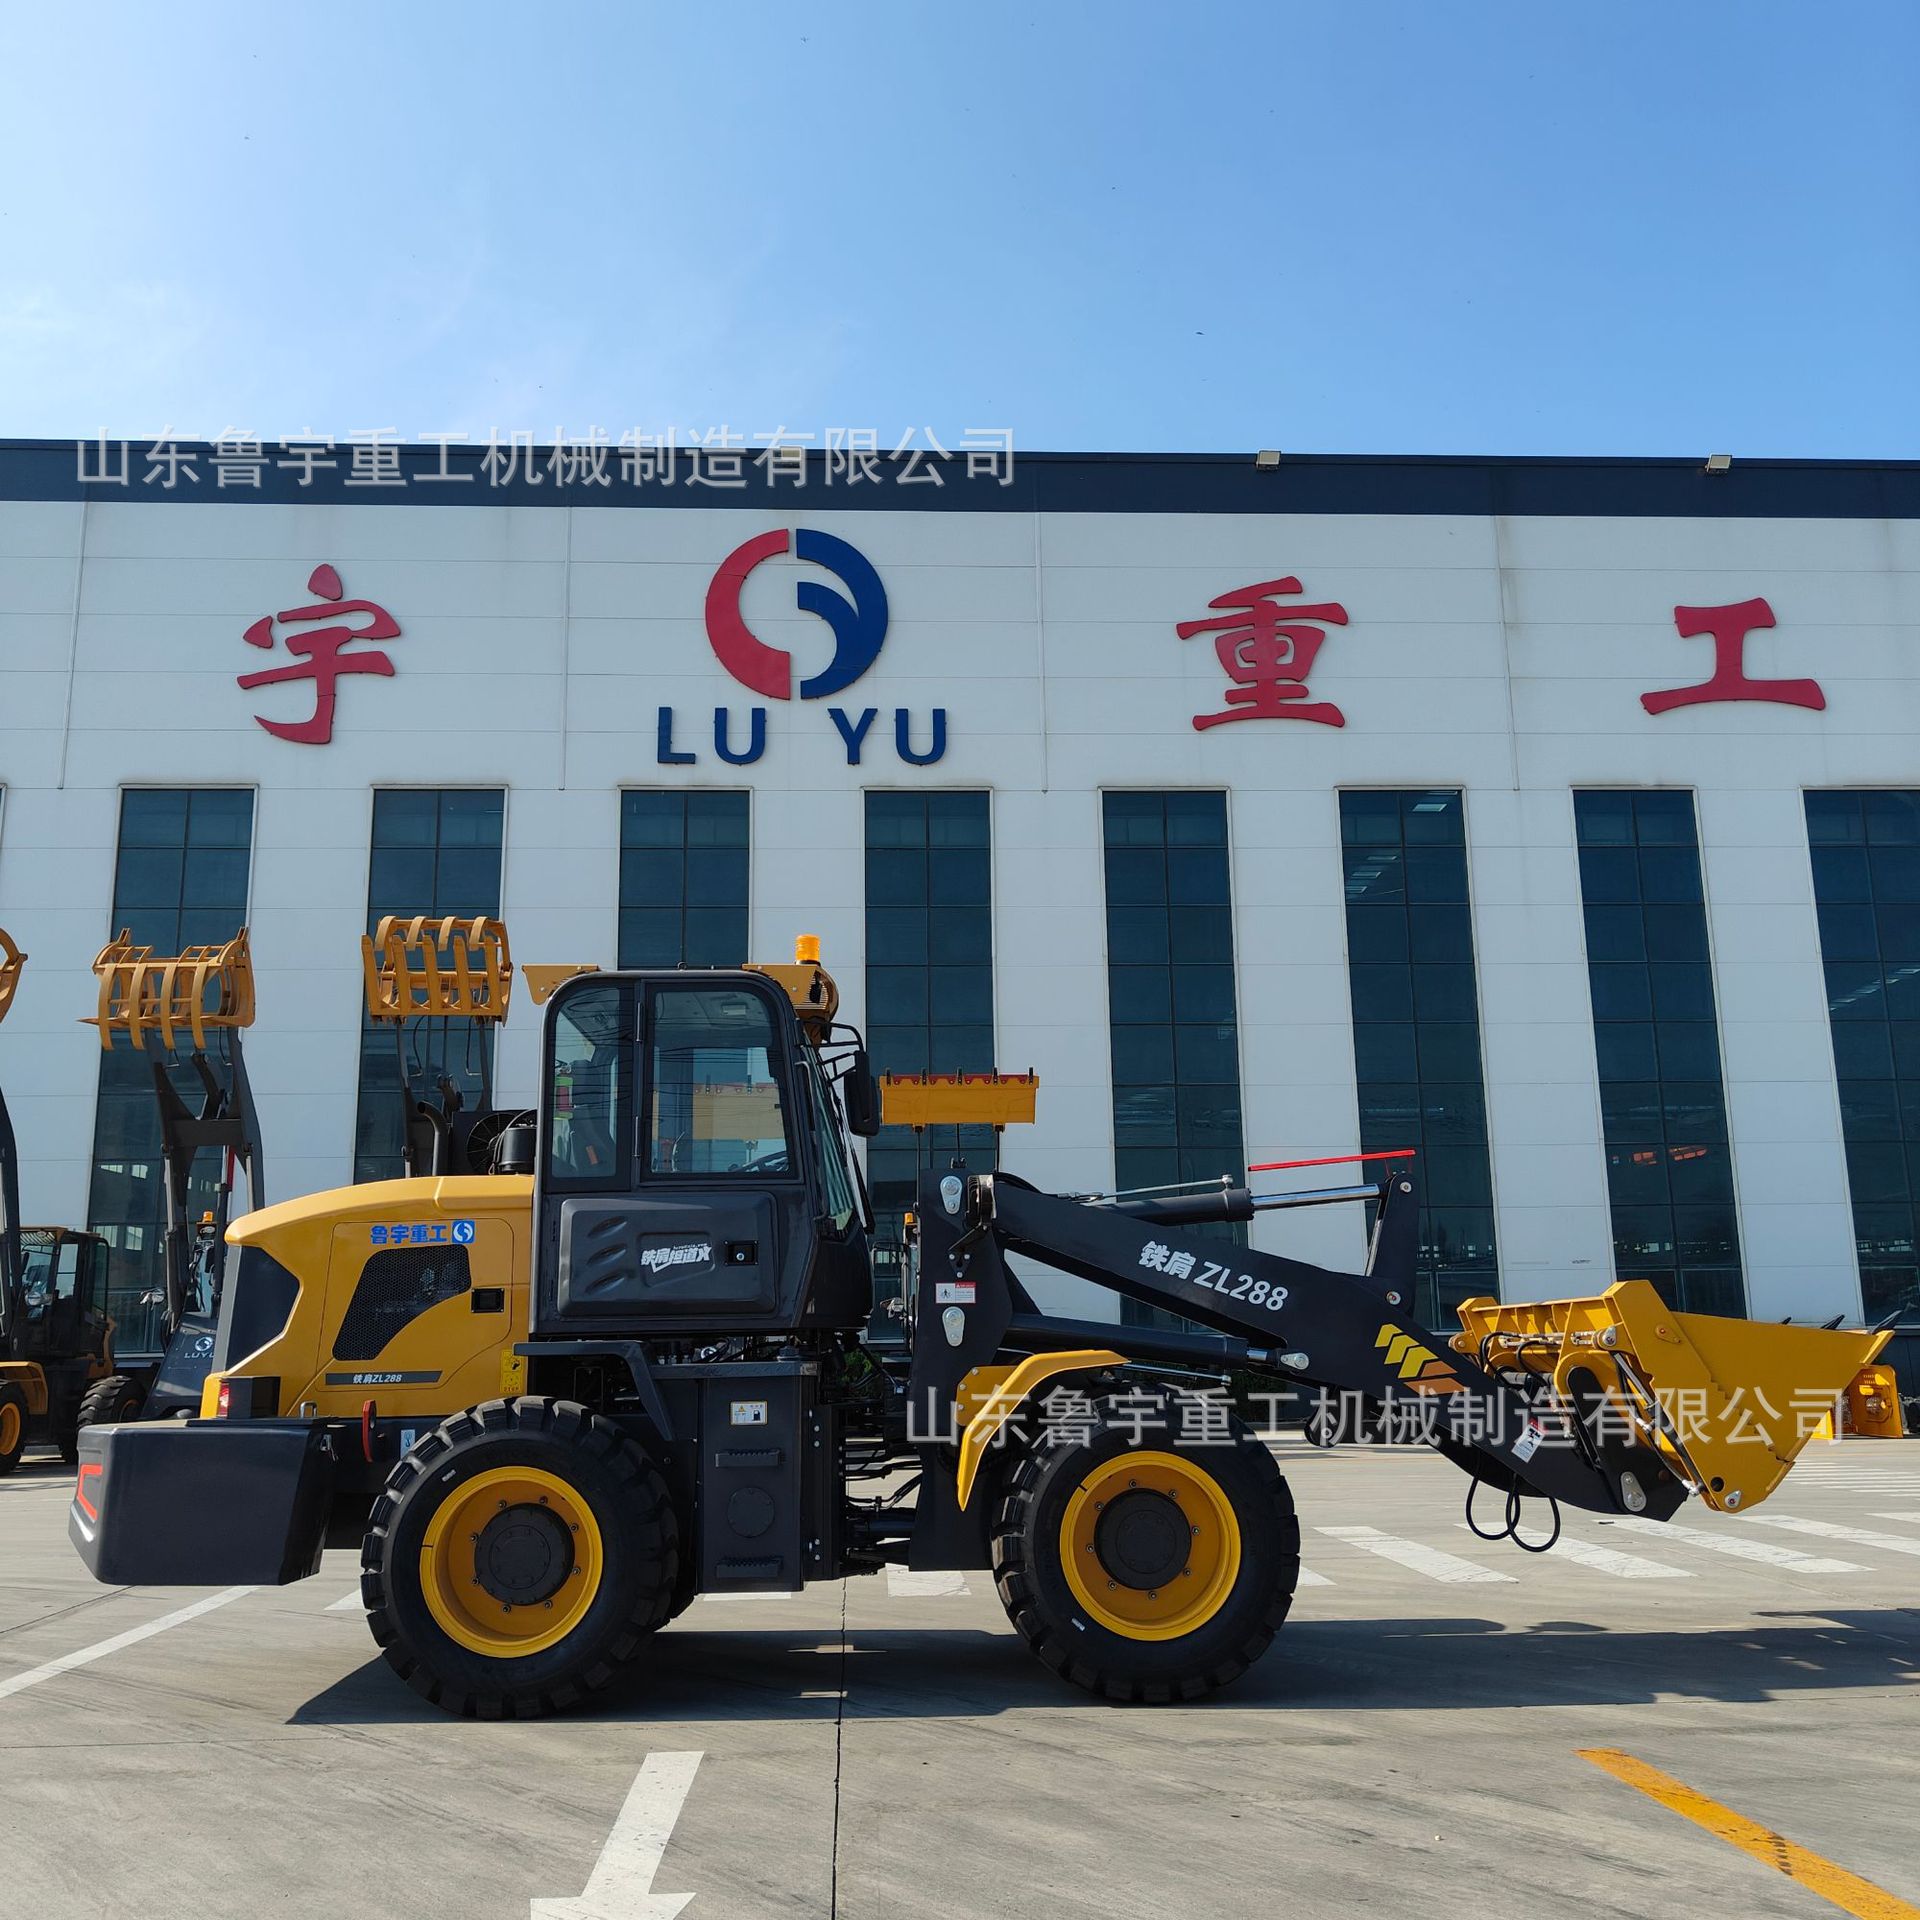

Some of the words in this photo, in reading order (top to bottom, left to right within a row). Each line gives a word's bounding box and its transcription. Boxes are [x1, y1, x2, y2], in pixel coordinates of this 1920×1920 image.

[238, 565, 400, 743] 宇
[1176, 576, 1348, 731] 重
[1641, 598, 1825, 714] 工
[656, 706, 767, 764] LU
[828, 706, 946, 764] YU
[370, 1224, 448, 1244] 鲁宇重工
[1138, 1240, 1197, 1280] 铁肩
[1193, 1261, 1289, 1311] ZL288
